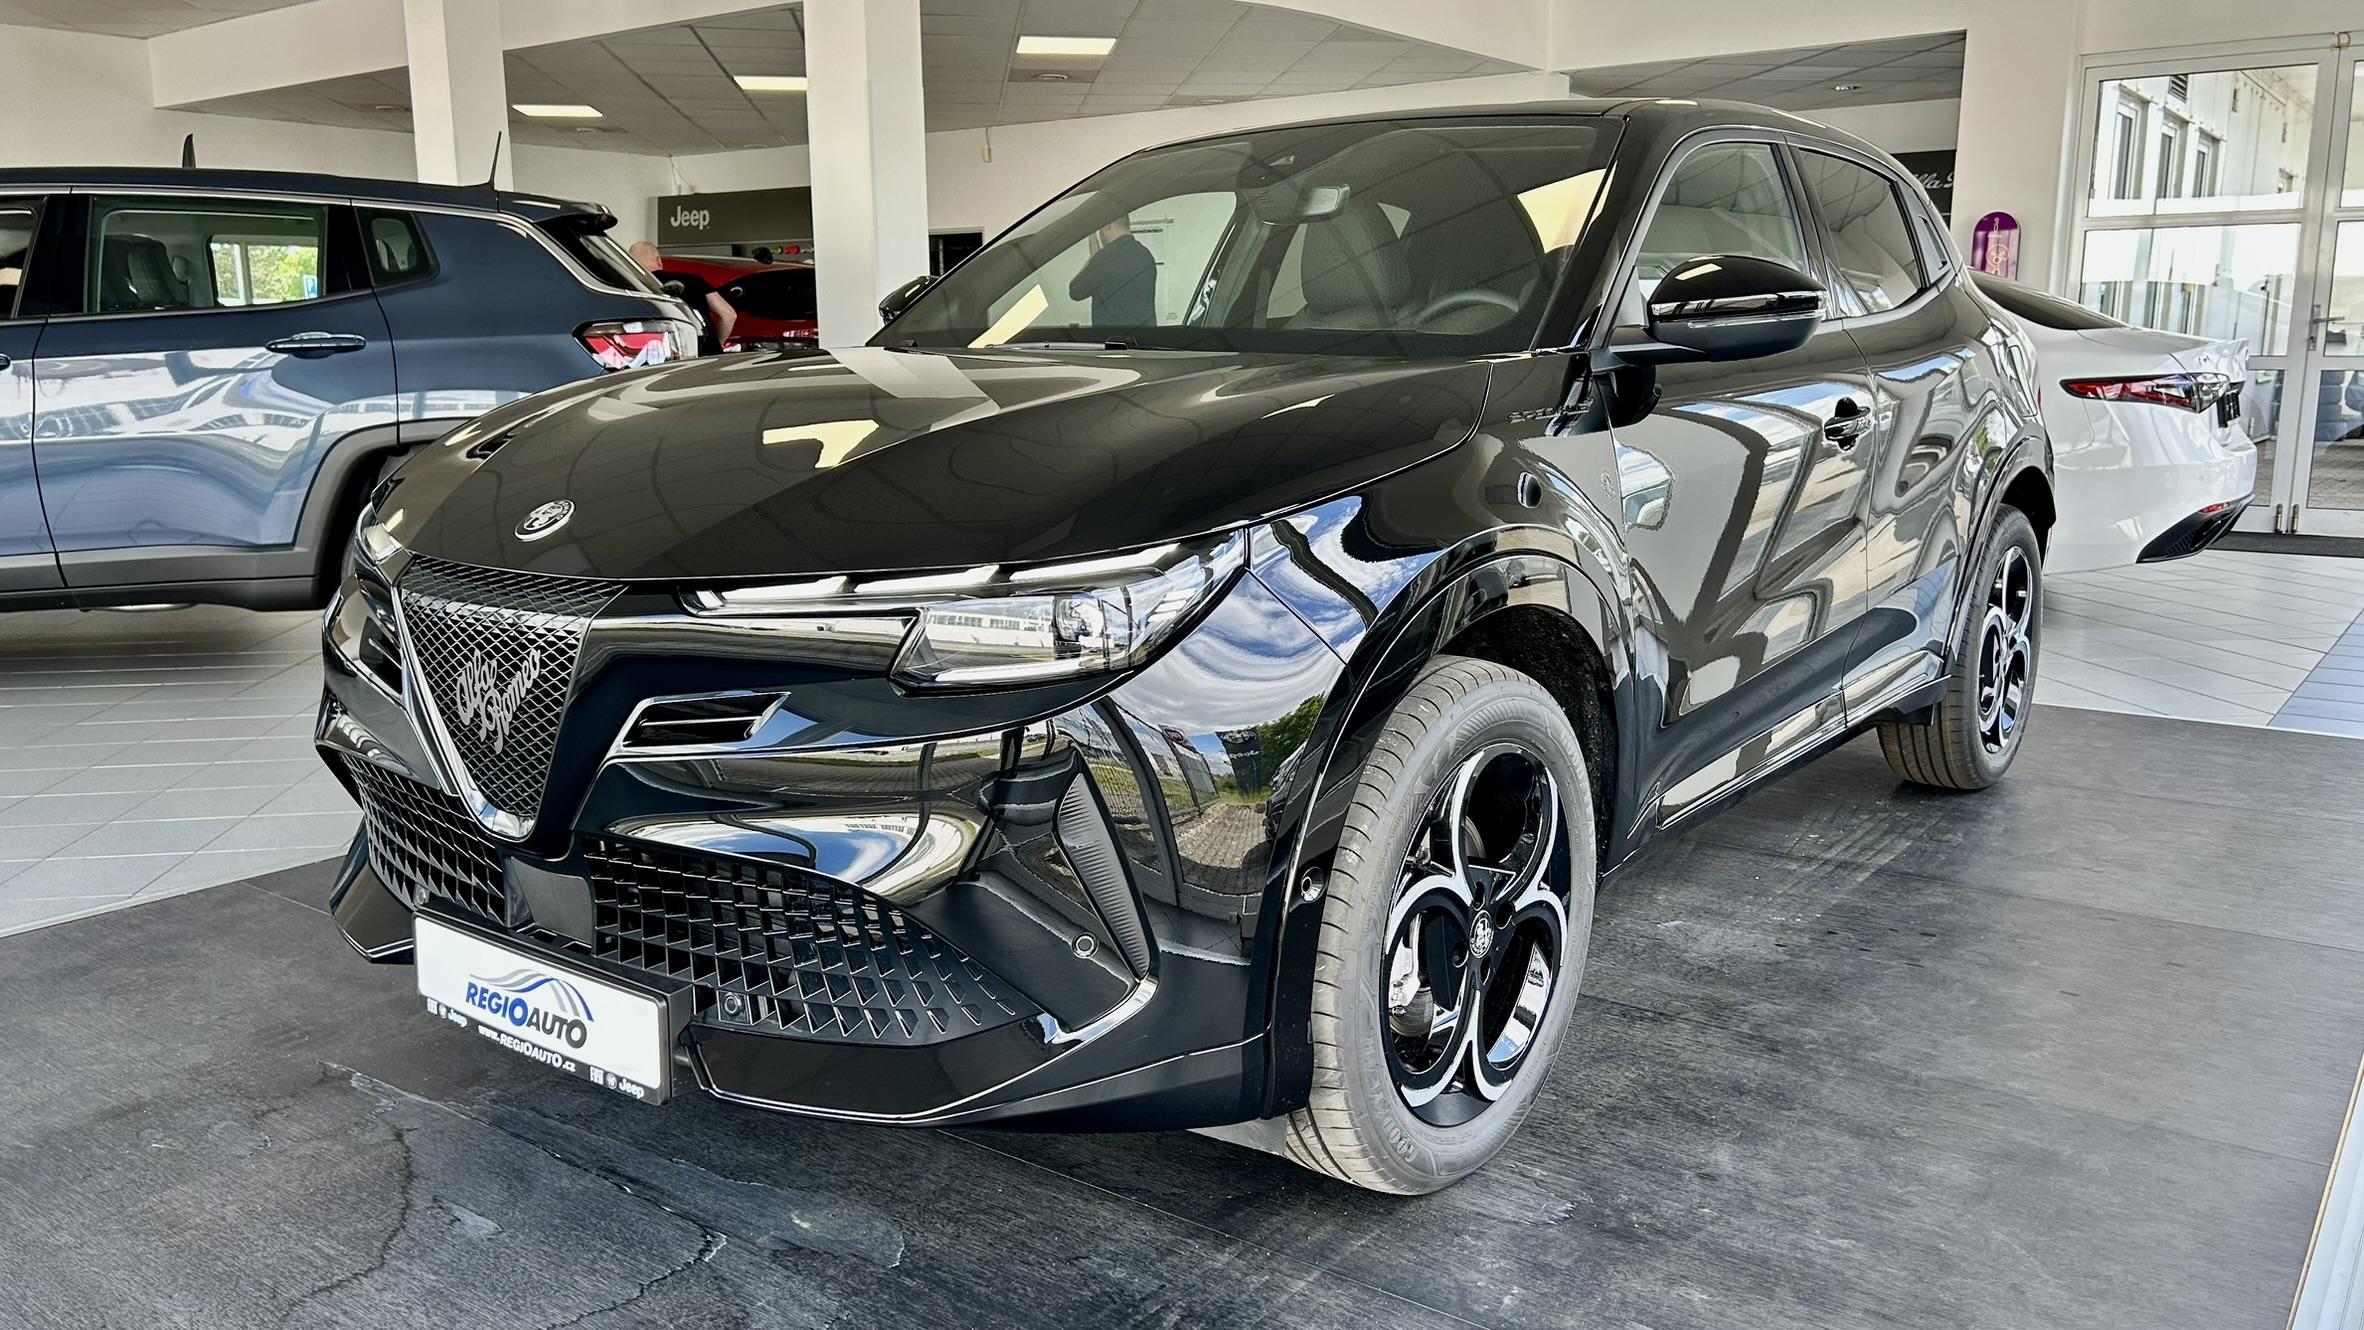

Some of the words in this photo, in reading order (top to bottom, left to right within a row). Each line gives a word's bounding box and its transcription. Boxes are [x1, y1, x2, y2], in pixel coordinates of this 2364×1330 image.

[670, 206, 710, 230] Jeep
[456, 648, 498, 726] Alfa
[480, 648, 541, 755] Romeo
[465, 981, 588, 1049] REGIOAUTO
[618, 1078, 644, 1099] Jeep
